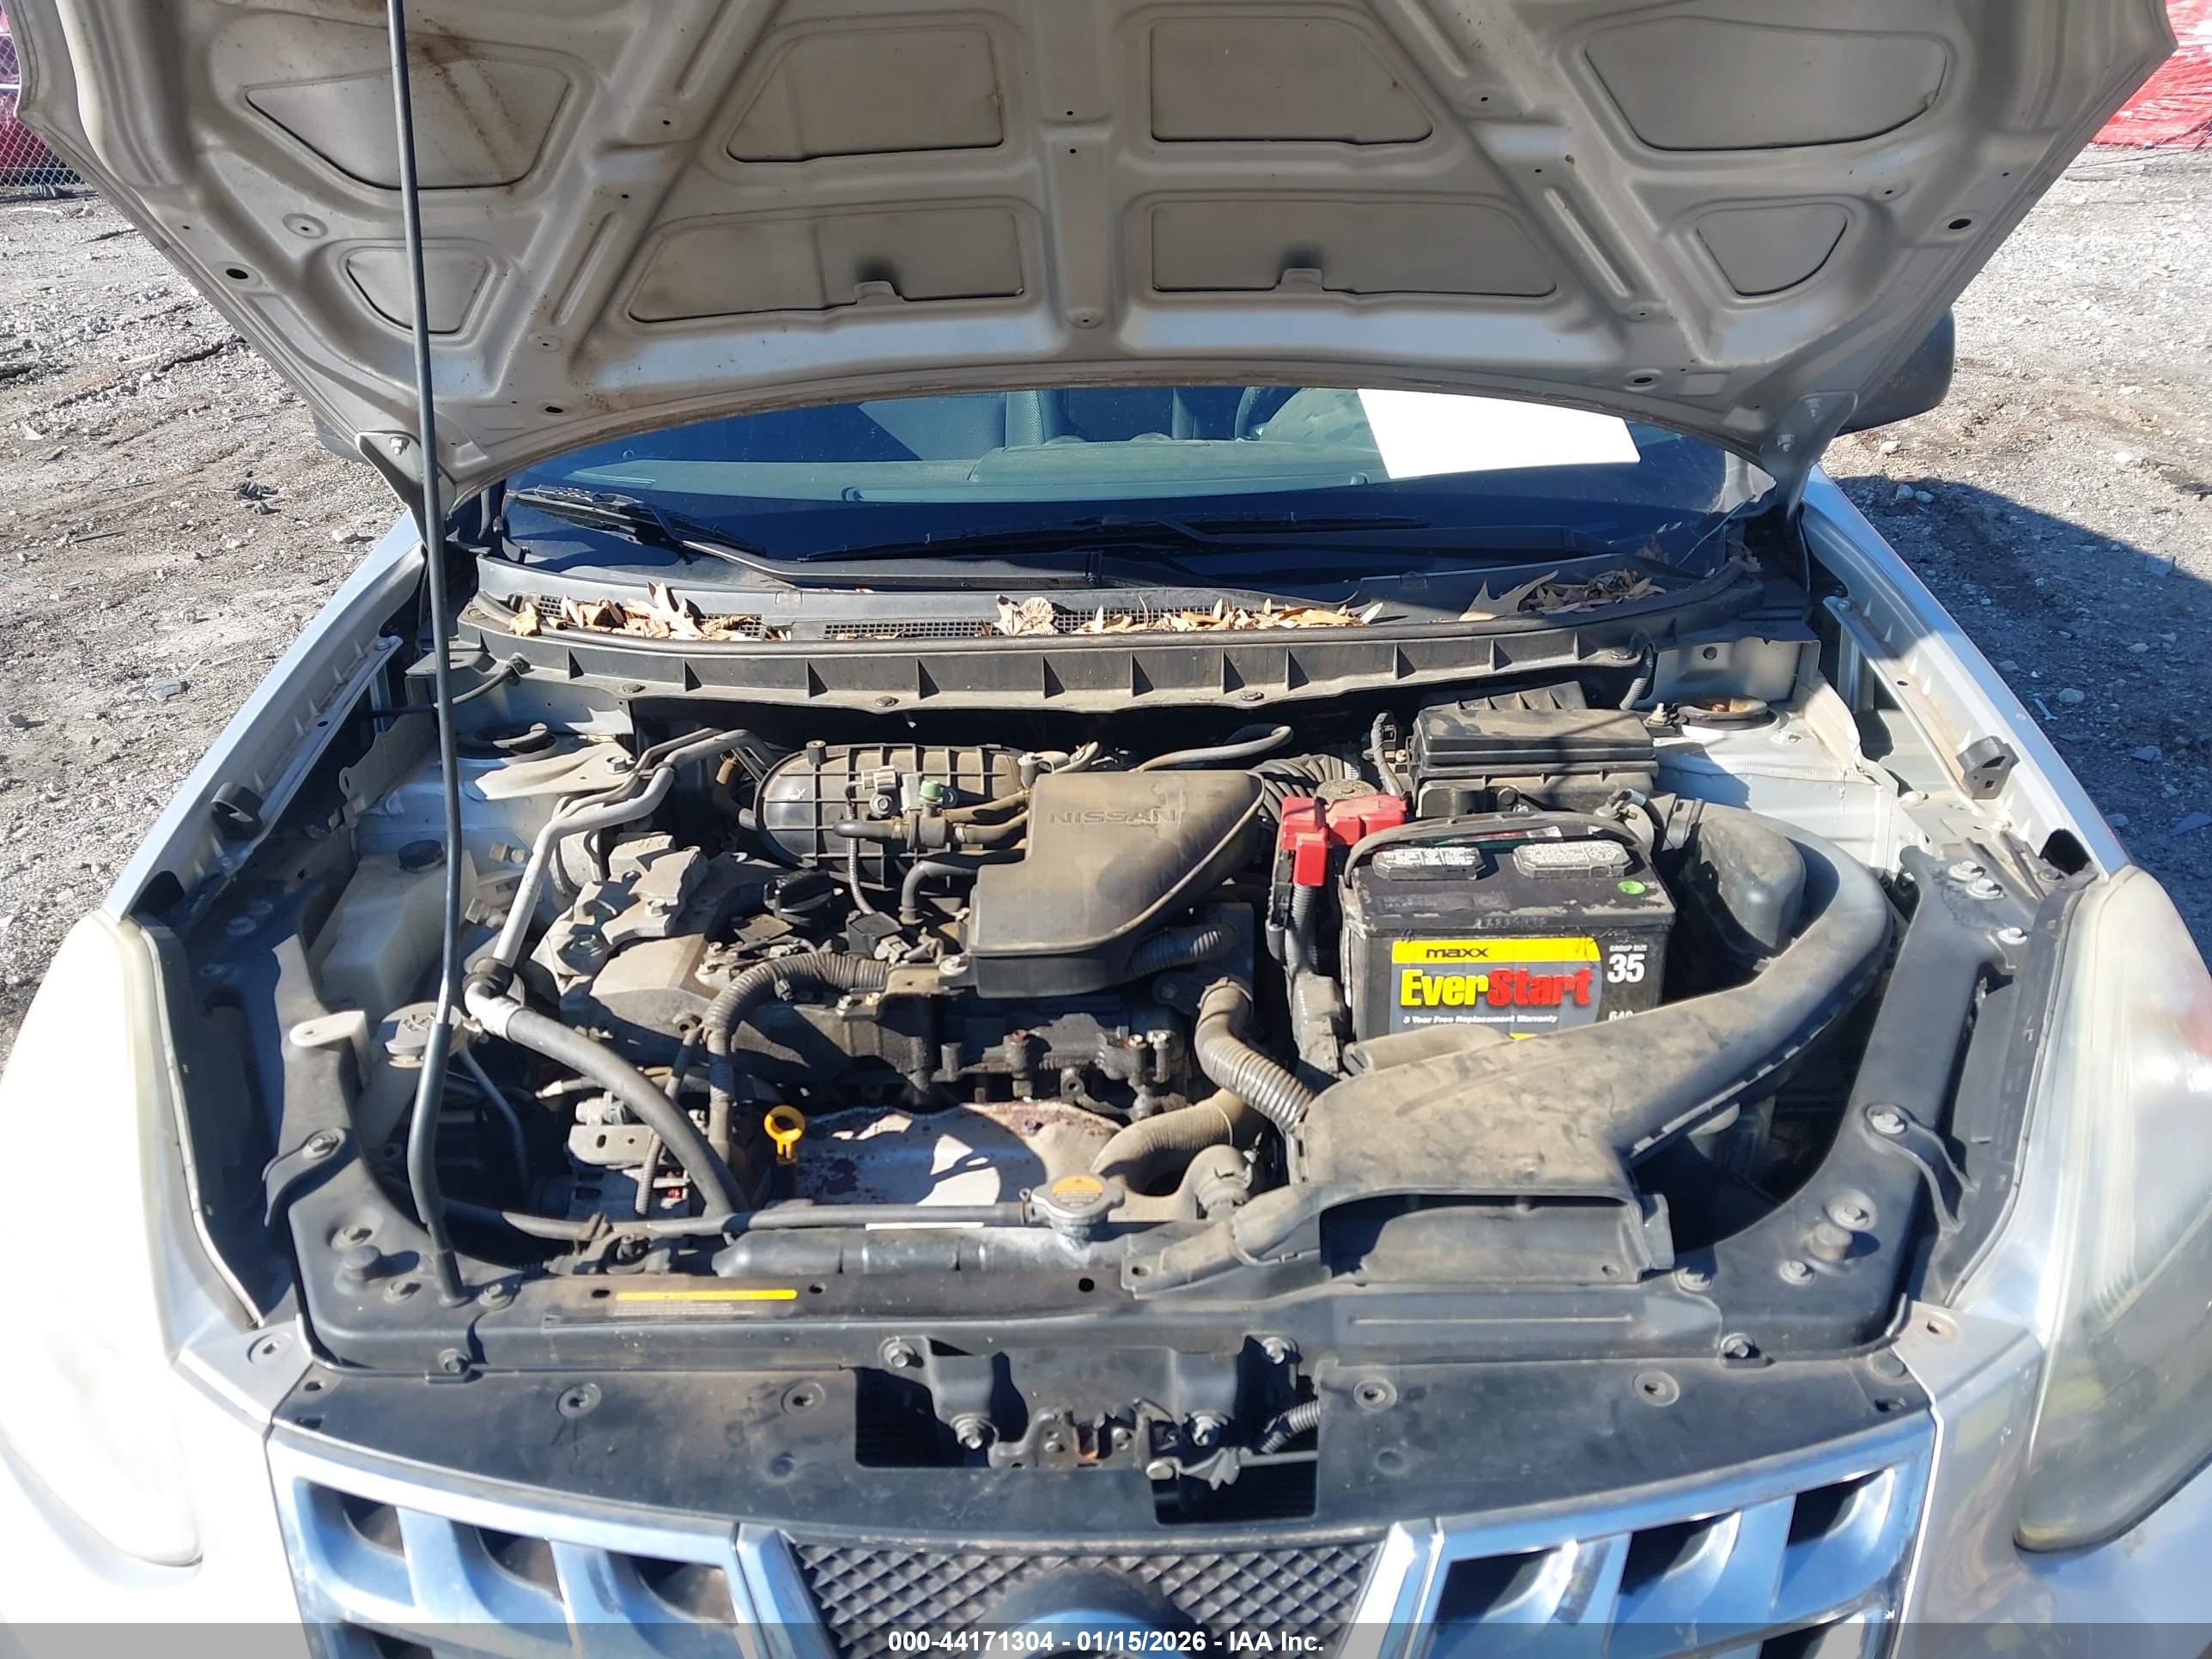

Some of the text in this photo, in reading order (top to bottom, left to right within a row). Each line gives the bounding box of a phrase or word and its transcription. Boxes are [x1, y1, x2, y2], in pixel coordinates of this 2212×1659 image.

[1049, 809, 1176, 823] NISSAN
[1425, 947, 1490, 958] maxx
[1607, 953, 1645, 983] 35
[1400, 967, 1594, 1007] EverStart
[1455, 1015, 1516, 1024] Replacement
[1516, 1014, 1559, 1024] Warranty
